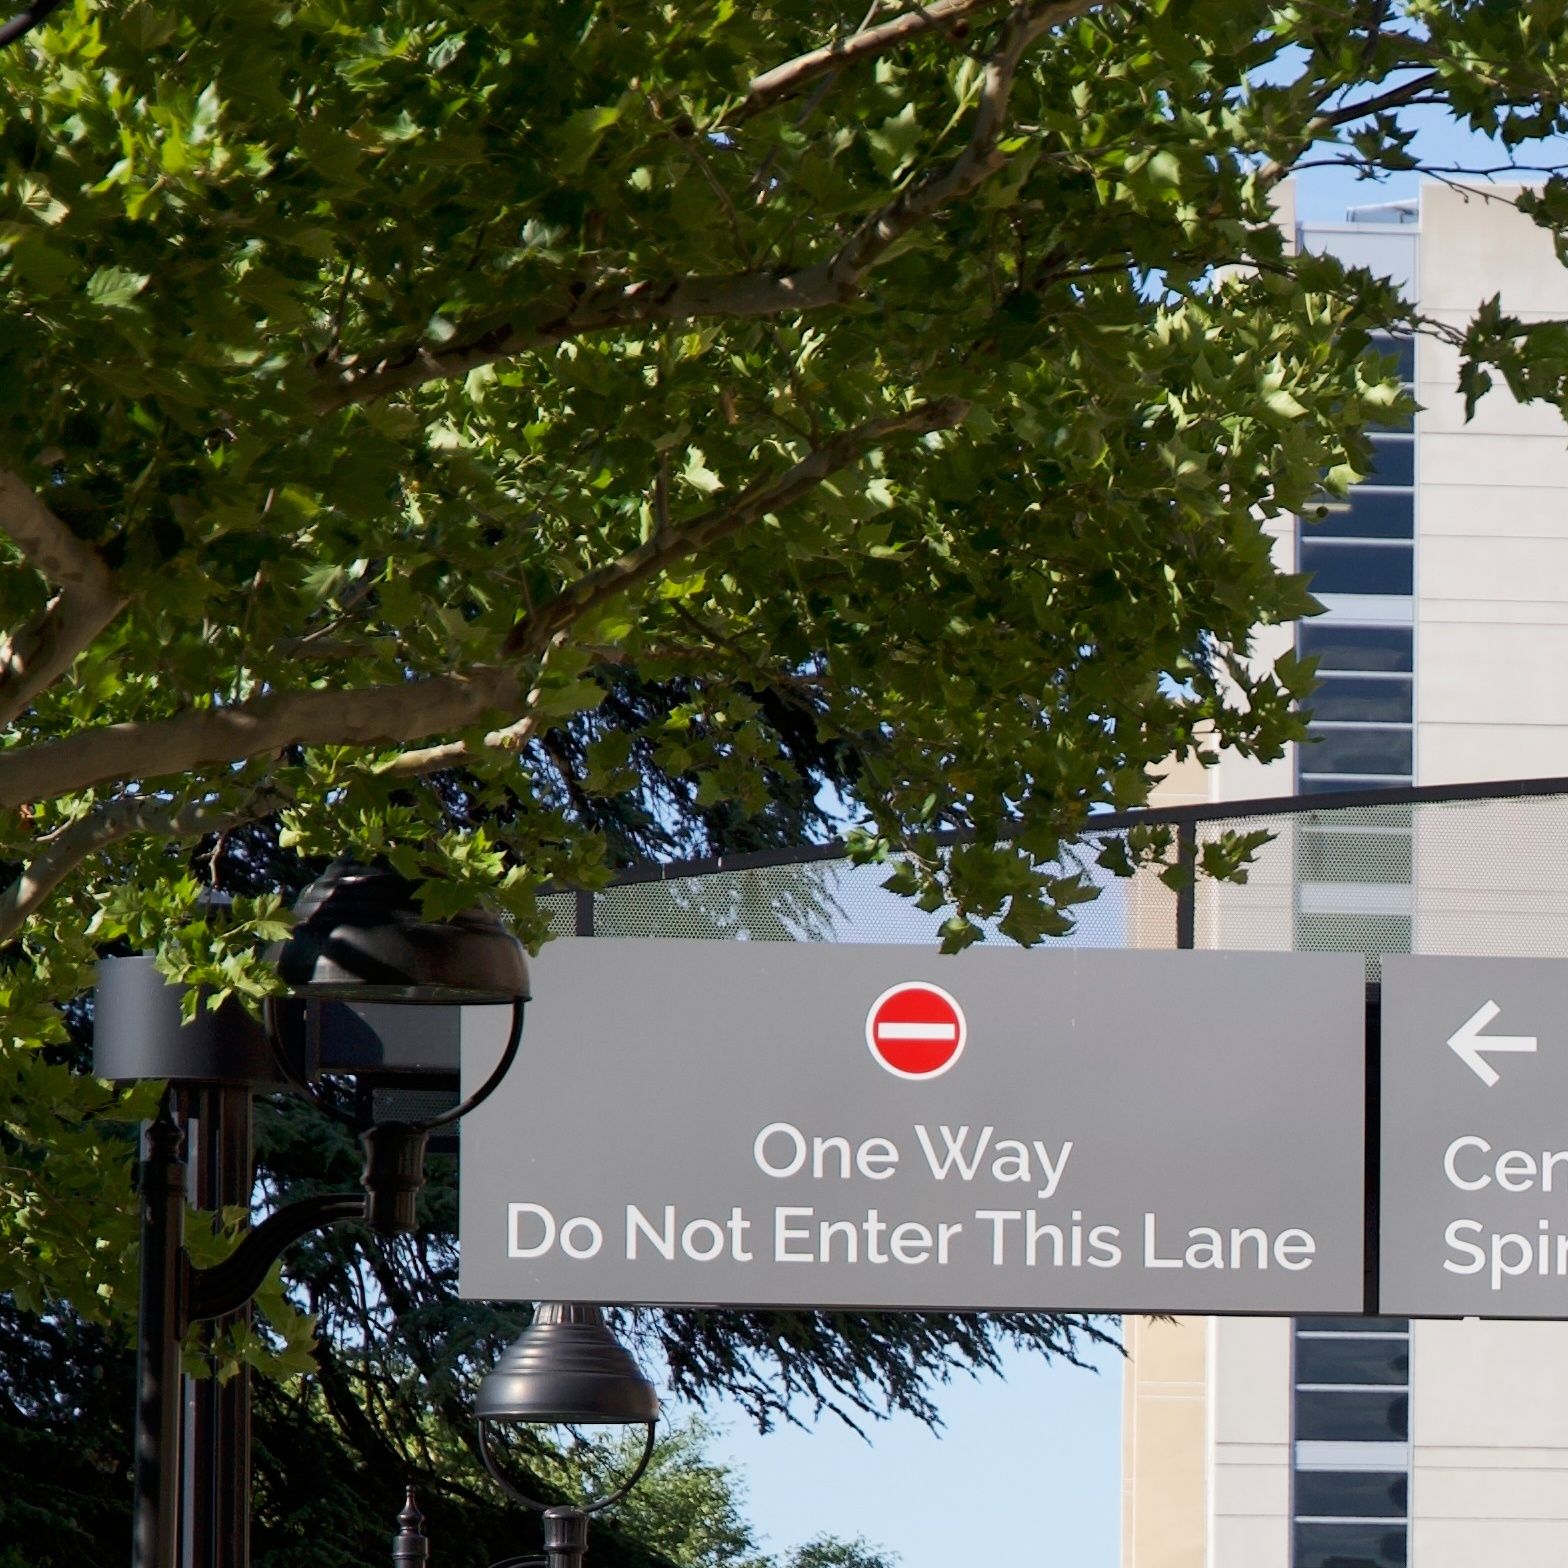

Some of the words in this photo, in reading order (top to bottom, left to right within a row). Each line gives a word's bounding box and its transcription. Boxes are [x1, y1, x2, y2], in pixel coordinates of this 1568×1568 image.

[753, 1122, 900, 1181] One
[913, 1123, 1074, 1200] Way
[507, 1201, 604, 1260] Do
[625, 1203, 754, 1263] Not
[774, 1205, 963, 1266] Enter
[974, 1208, 1123, 1269] This
[1143, 1212, 1317, 1272] Lane
